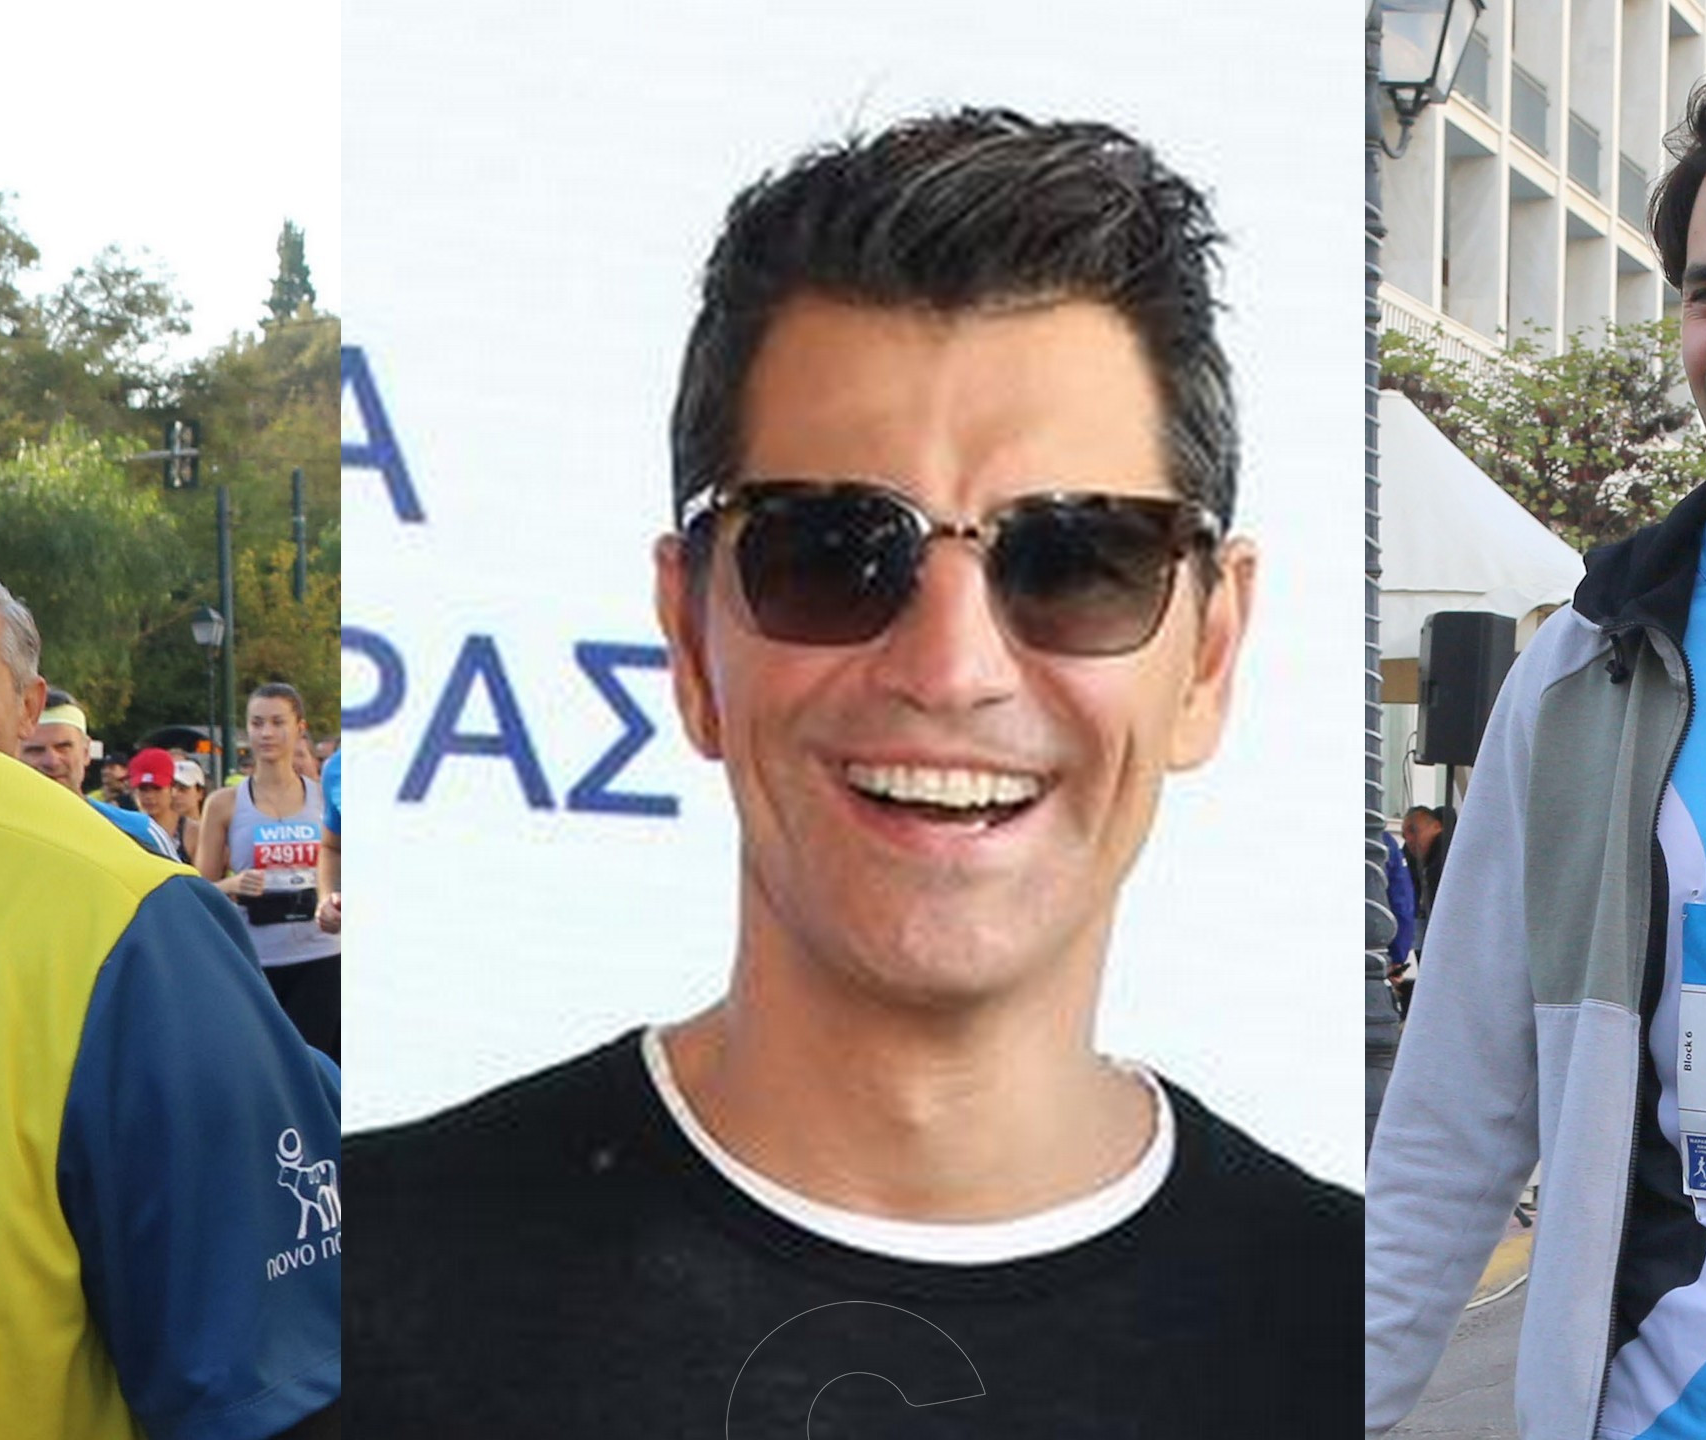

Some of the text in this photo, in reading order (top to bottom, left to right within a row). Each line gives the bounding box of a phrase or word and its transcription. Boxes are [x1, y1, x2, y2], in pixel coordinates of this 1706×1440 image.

[260, 826, 315, 840] WIND
[260, 845, 315, 864] 24911
[1684, 1040, 1692, 1071] Block
[267, 1243, 315, 1281] novo
